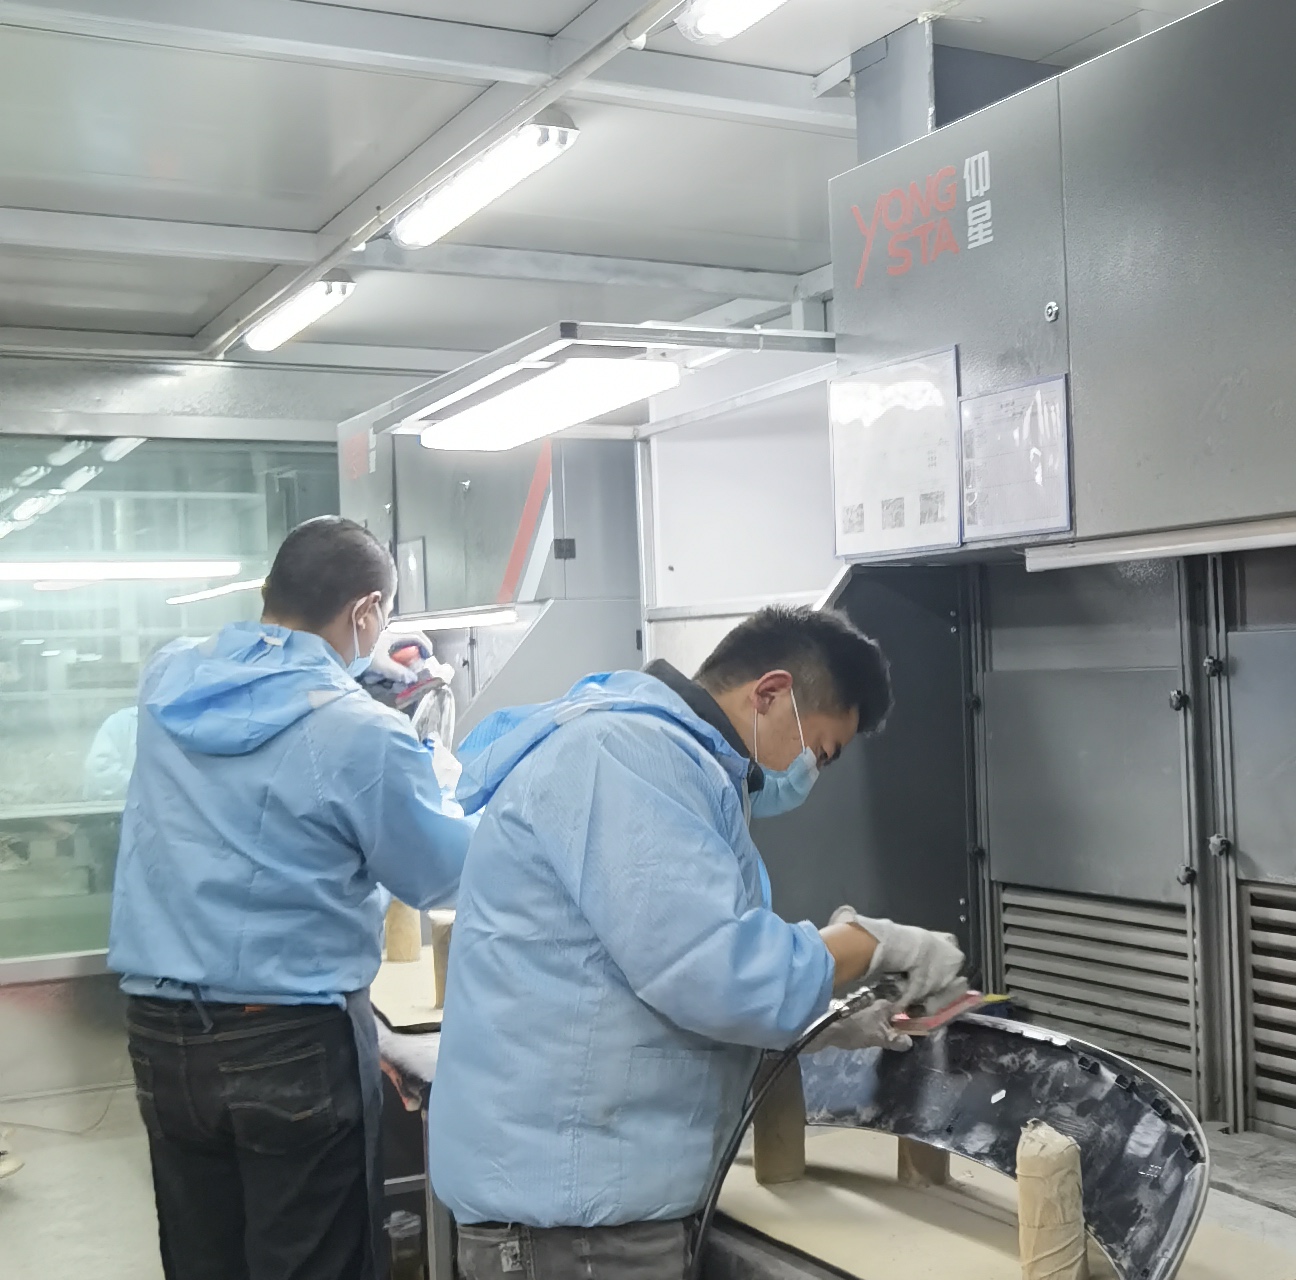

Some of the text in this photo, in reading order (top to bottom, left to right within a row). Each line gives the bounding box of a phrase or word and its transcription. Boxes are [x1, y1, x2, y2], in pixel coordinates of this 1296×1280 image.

[851, 165, 958, 289] YONG
[886, 217, 961, 277] STA
[963, 150, 994, 250] 仰星
